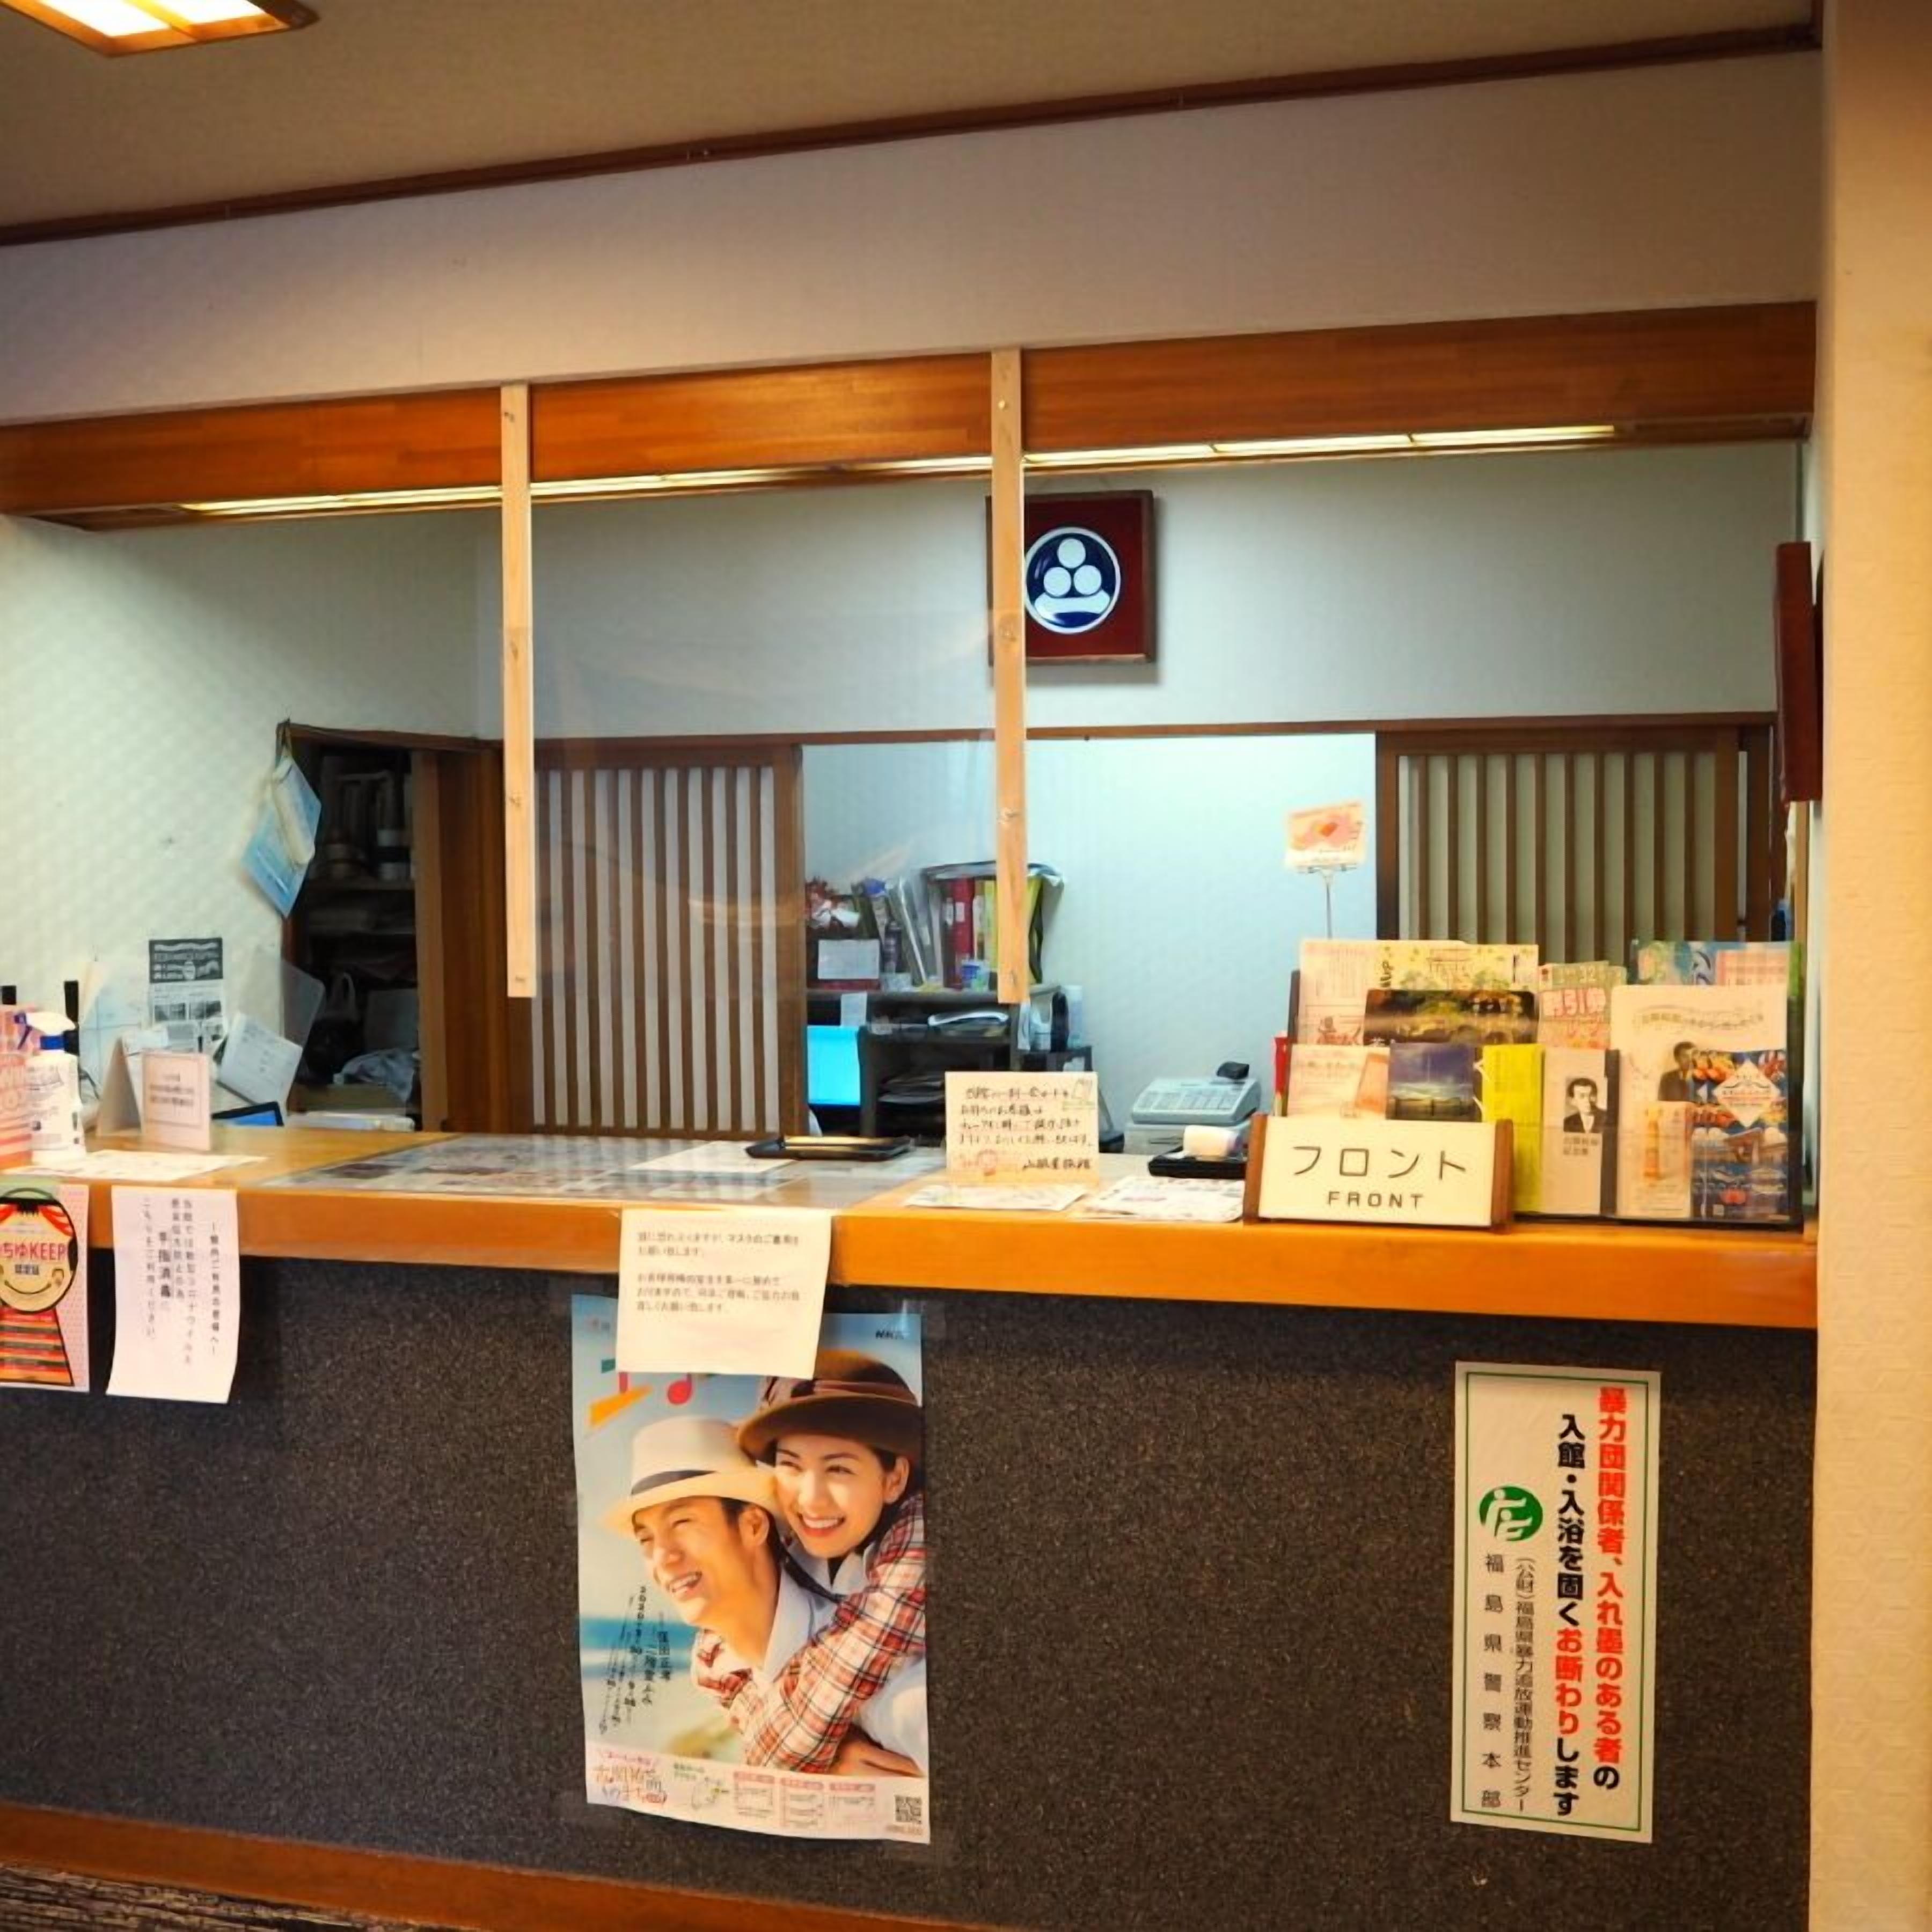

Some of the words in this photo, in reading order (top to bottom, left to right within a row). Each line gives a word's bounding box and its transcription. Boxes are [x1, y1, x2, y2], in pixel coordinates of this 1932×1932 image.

[1292, 1145, 1467, 1180] フロント
[1327, 1191, 1424, 1210] FRONT
[1553, 1414, 1586, 1817] 入館・入浴を固くお断わりします
